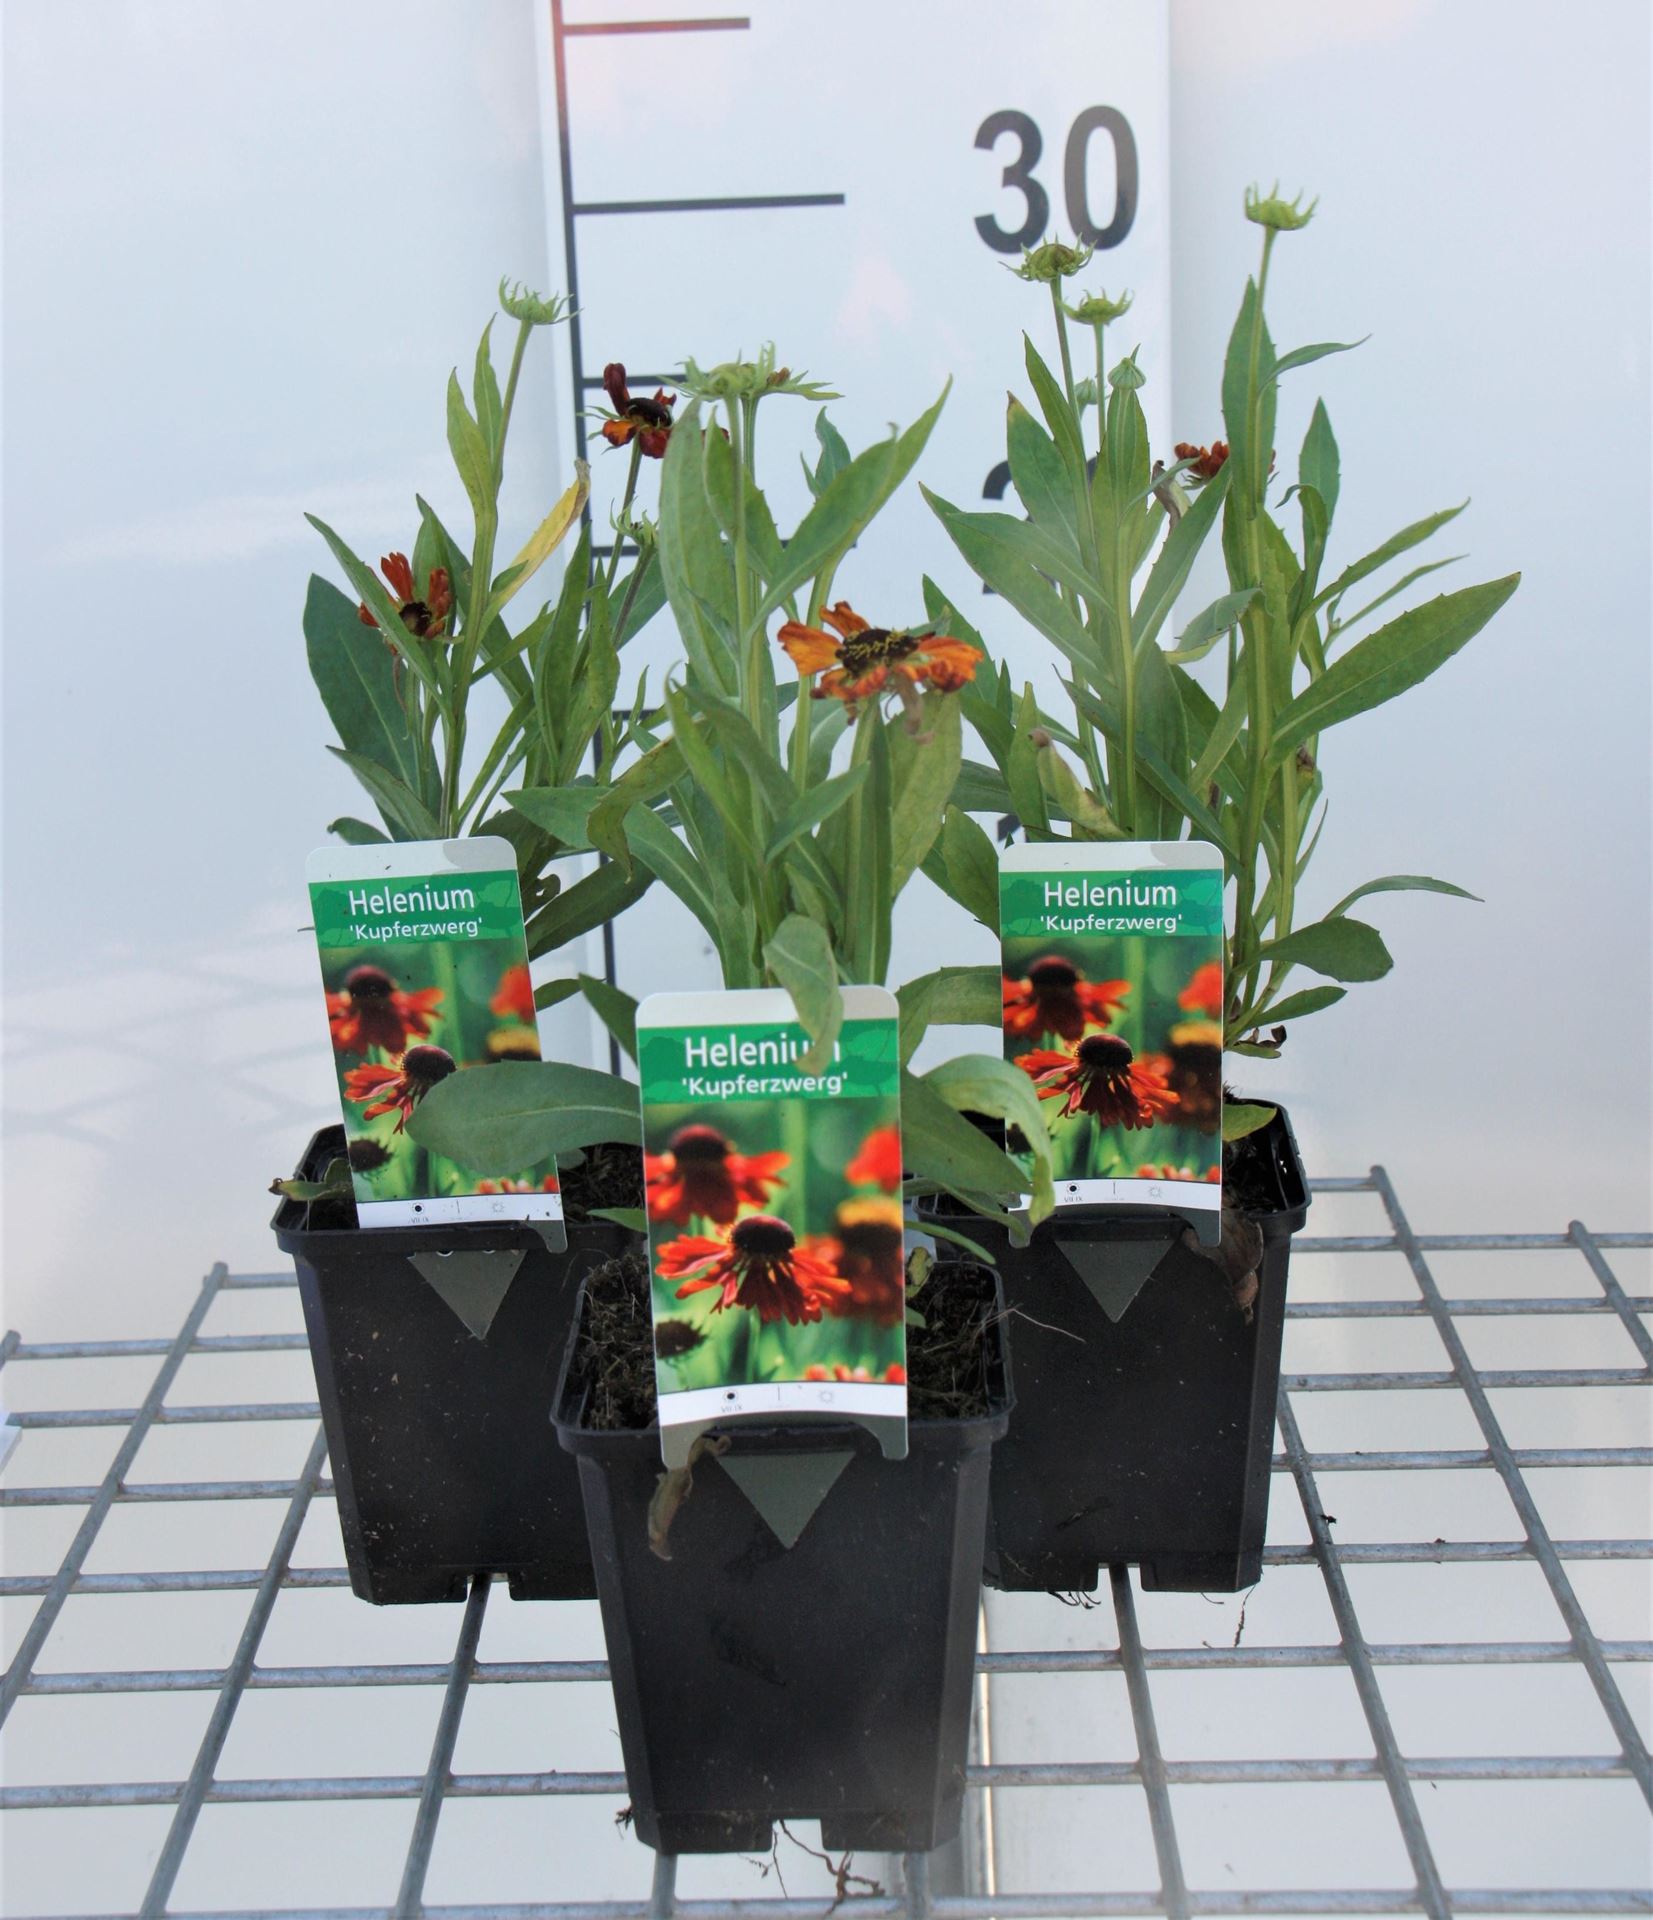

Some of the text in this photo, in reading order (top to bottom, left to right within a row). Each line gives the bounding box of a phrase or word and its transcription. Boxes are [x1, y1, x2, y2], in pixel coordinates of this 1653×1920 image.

[974, 105, 1139, 254] 30
[349, 883, 475, 916] Helenium
[1044, 879, 1177, 907] Helenium
[350, 917, 482, 942] 'Kupferzwerg'
[1040, 913, 1182, 934] 'Kupferzwerg'
[682, 1071, 848, 1100] 'Kupferzwerg'
